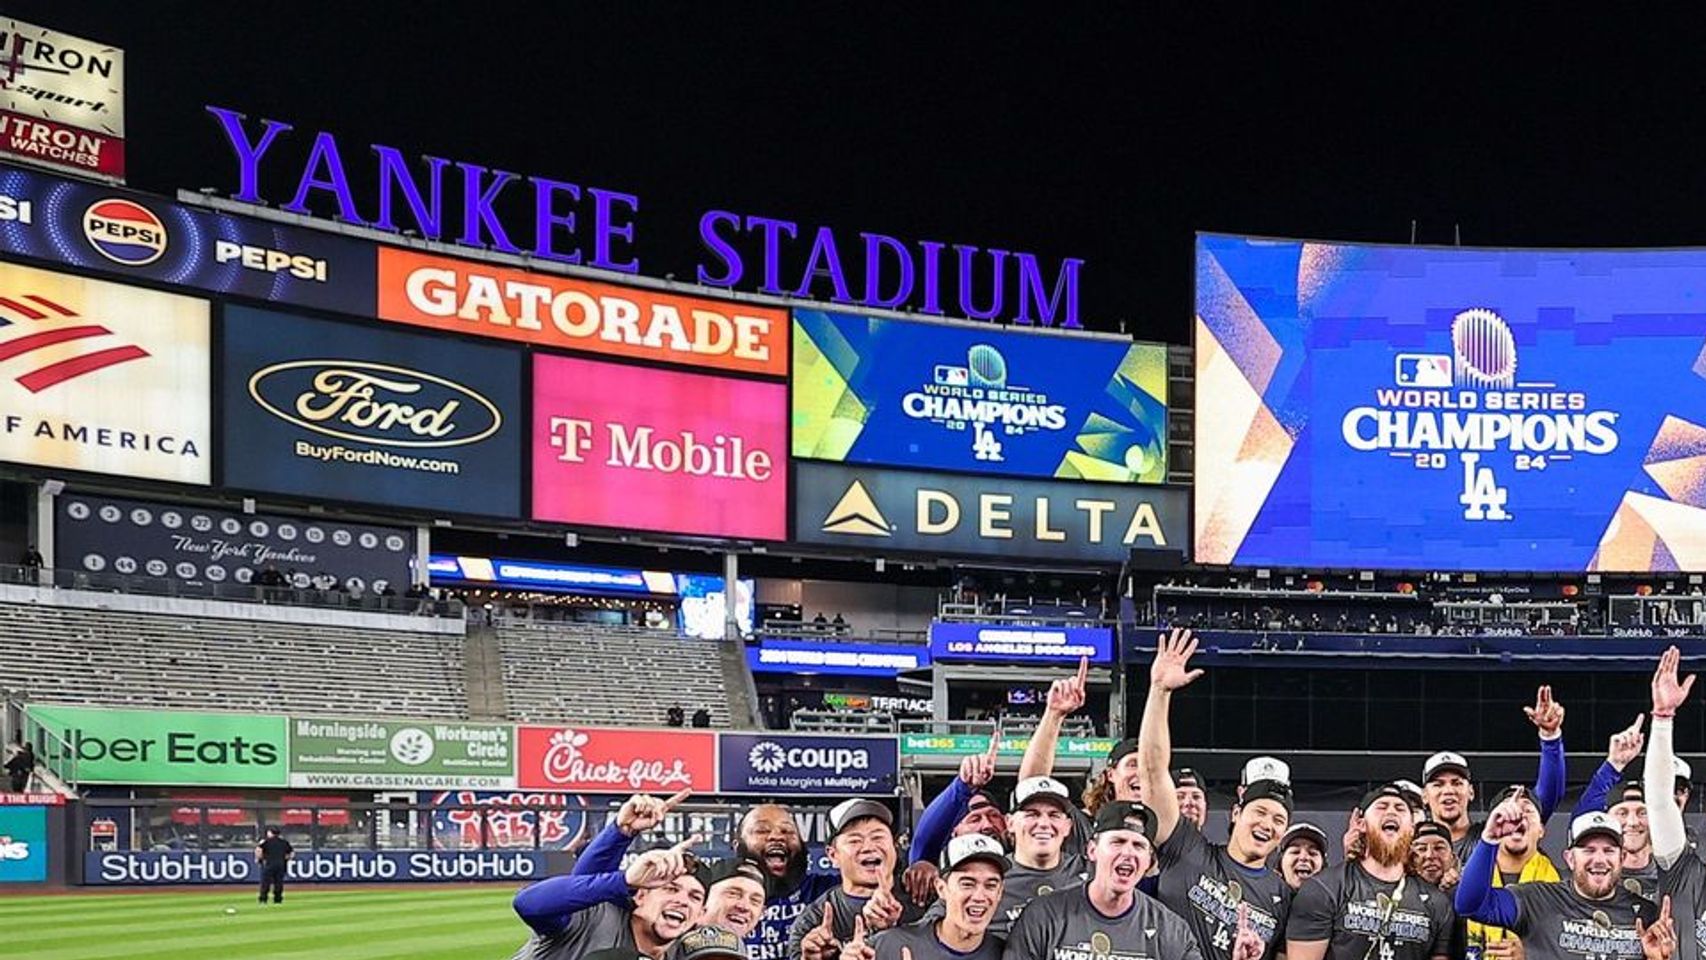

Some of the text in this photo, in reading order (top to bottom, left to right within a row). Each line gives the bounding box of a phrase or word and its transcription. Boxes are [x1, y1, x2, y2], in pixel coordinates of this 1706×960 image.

[10, 136, 99, 167] WATCHES
[206, 105, 1085, 329] YANKEE STADIUM
[89, 218, 162, 246] PEPSI
[216, 240, 327, 282] PEPSI
[405, 268, 770, 361] GATORADE
[296, 369, 458, 438] Ford
[923, 384, 1047, 404] WORLD SERIES
[1377, 389, 1585, 410] WORLD SERIES
[902, 392, 1067, 430] CHAMPIONS
[35, 420, 200, 459] AMERICA
[1342, 406, 1619, 454] CHAMPIONS
[295, 442, 459, 475] BuyFordNow.com
[605, 422, 772, 482] Mobile
[1414, 453, 1547, 470] 20 24
[1460, 452, 1508, 520] LA
[915, 489, 1168, 547] DELTA
[253, 543, 316, 565] Yankees
[297, 721, 387, 742] Morningside
[434, 725, 509, 742] Workmen's
[167, 731, 279, 766] Eats
[467, 743, 508, 758] Circle
[788, 748, 868, 774] coupa
[748, 776, 777, 786] Make
[780, 777, 823, 788] Margins
[101, 853, 249, 881] StubHub
[287, 854, 396, 879] tubHub
[410, 852, 534, 877] StubHub
[1390, 910, 1430, 928] SERIES
[1563, 921, 1607, 939] WORLD
